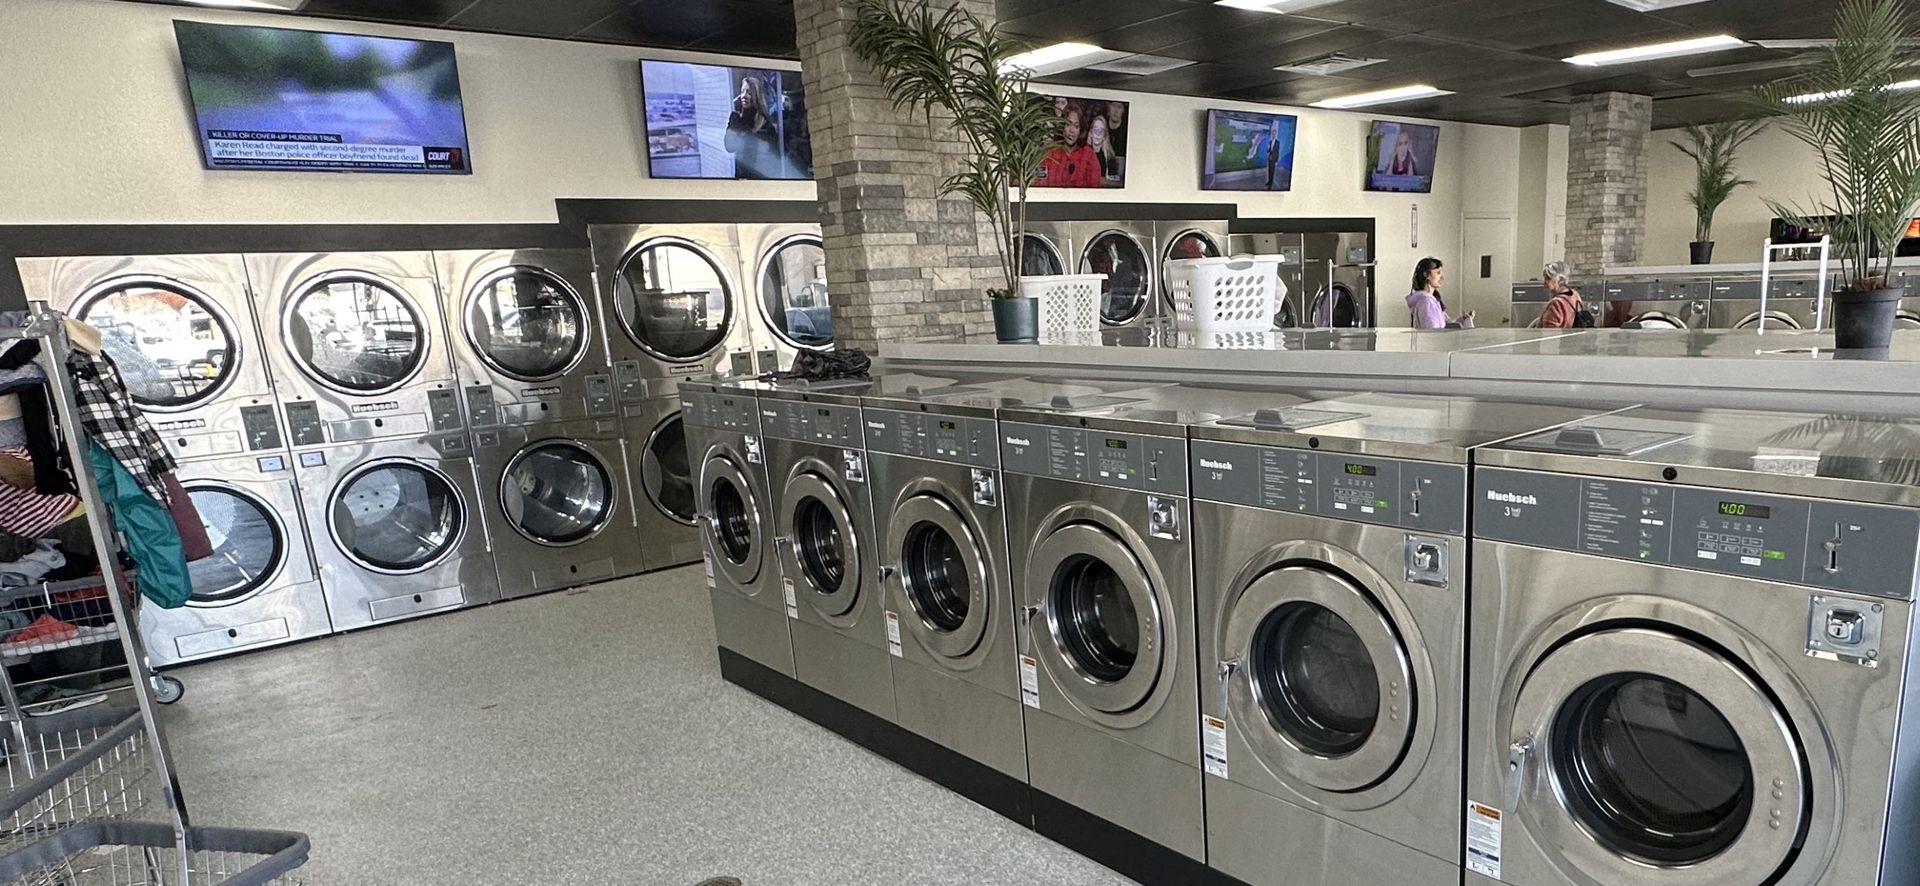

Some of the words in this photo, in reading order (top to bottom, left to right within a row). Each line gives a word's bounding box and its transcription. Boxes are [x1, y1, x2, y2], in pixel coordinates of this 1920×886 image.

[212, 131, 238, 139] KILLER
[251, 132, 287, 140] COVER-UP
[289, 133, 318, 141] MURDER
[320, 134, 338, 142] TRIAL
[215, 141, 240, 149] Karen
[242, 142, 264, 150] Read
[265, 142, 299, 152] charged
[320, 145, 377, 154] second-degree
[379, 146, 406, 154] murder
[216, 149, 238, 157] after
[255, 150, 285, 158] Boston
[286, 151, 310, 159] police
[312, 151, 338, 159] officer
[340, 152, 376, 161] boyfriend
[377, 153, 399, 161] found
[428, 151, 450, 161] COURT
[353, 402, 398, 413] Huebsch
[1200, 458, 1233, 471] Huebsch
[1487, 490, 1537, 505] Huebsch
[1504, 506, 1511, 517] 3
[1720, 503, 1746, 515] 4.00
